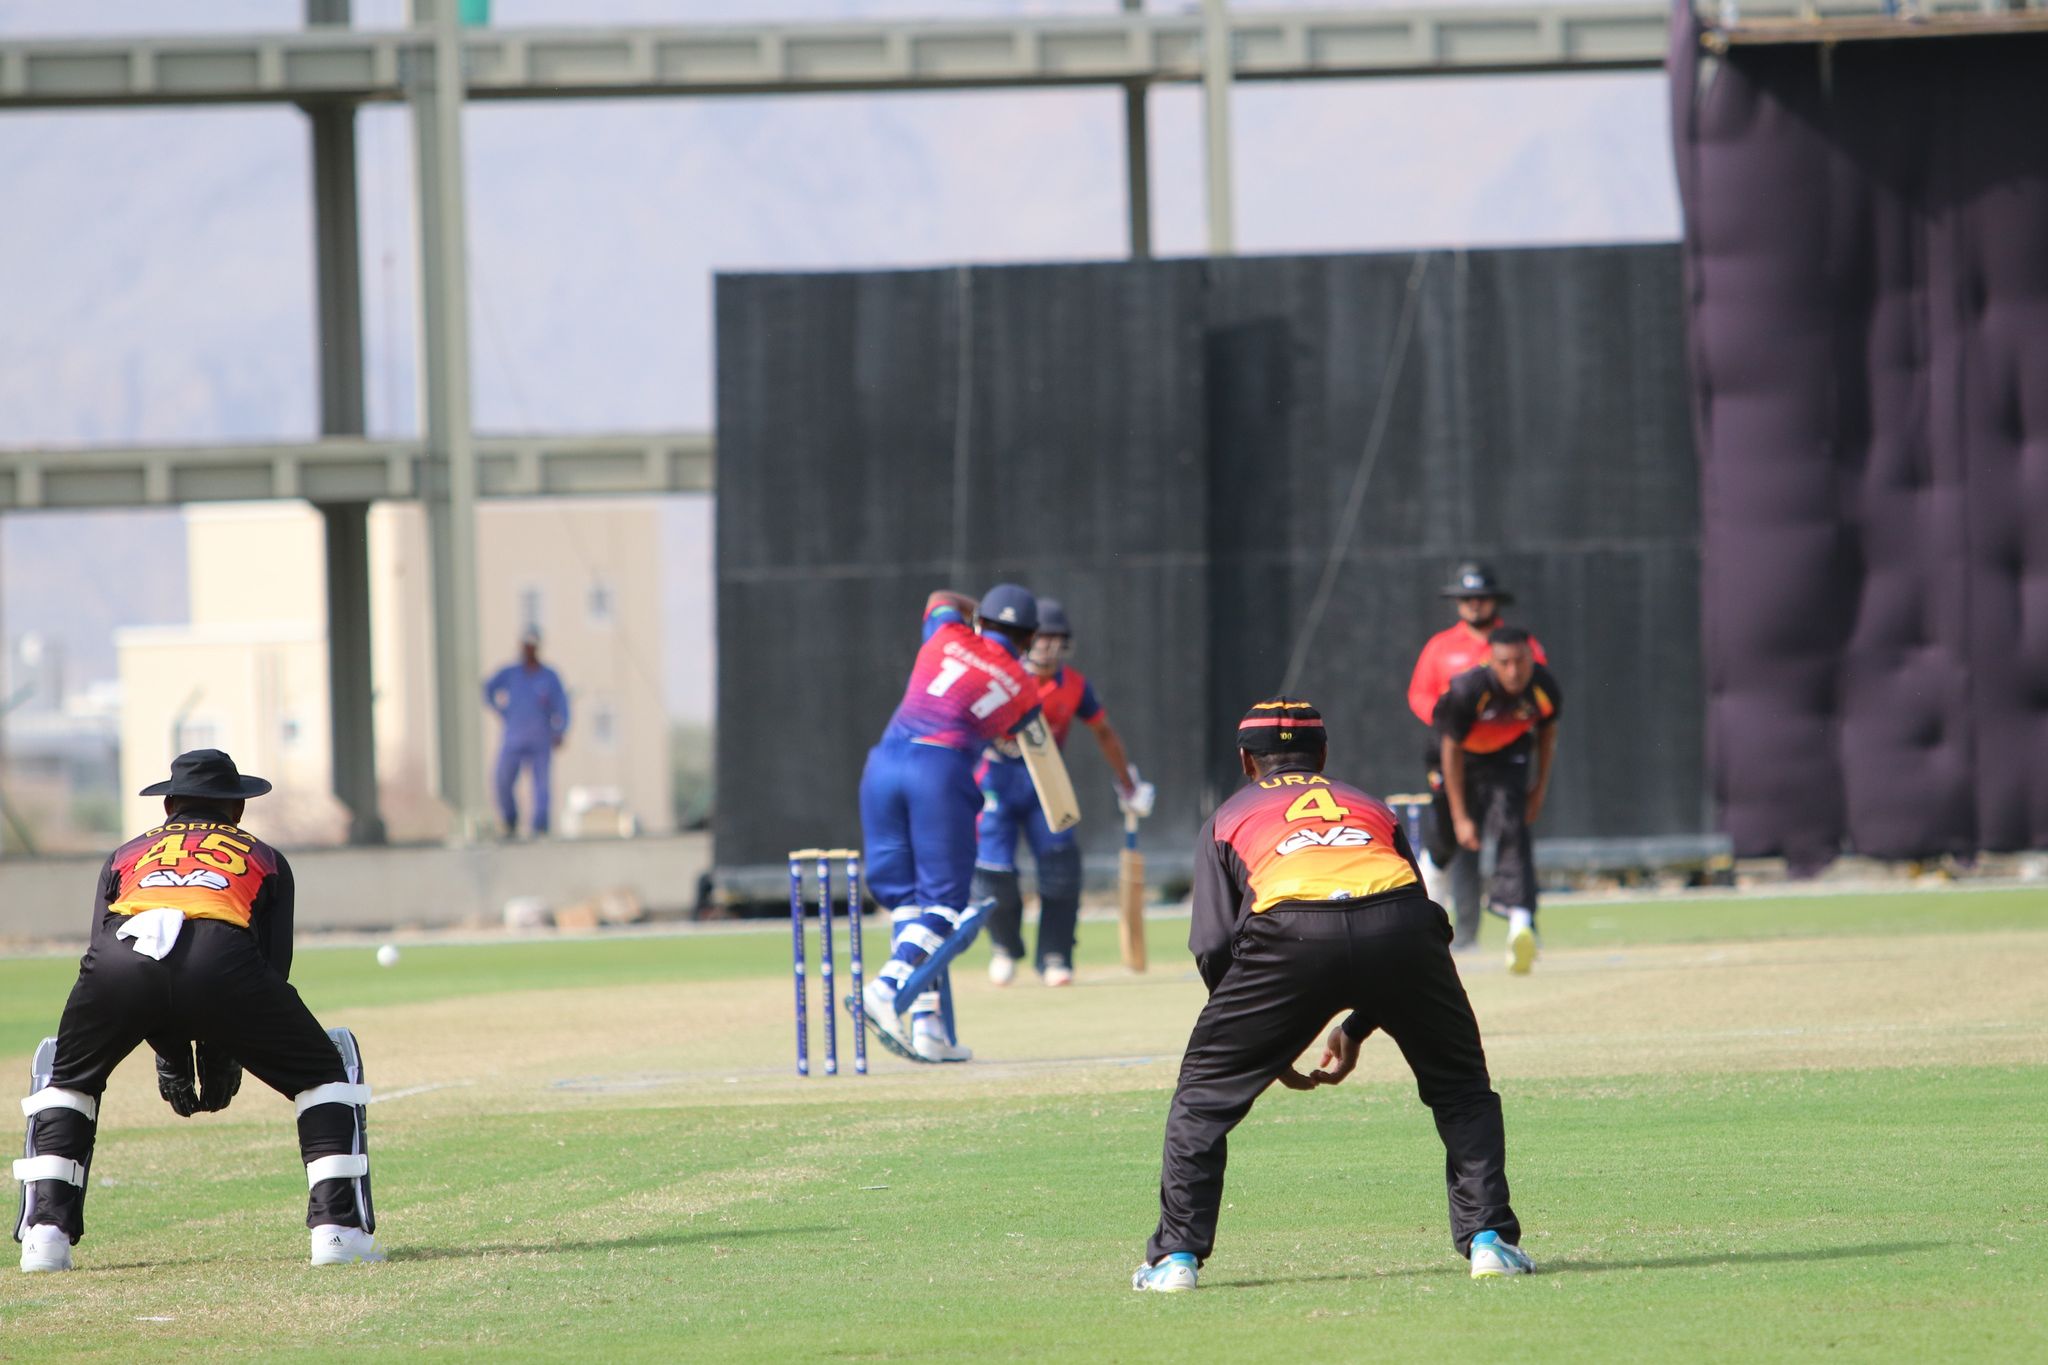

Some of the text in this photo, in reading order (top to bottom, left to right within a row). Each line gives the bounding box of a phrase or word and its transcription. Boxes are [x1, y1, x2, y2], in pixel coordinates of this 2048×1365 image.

[1259, 775, 1331, 789] URA
[1284, 787, 1351, 823] 4
[145, 823, 257, 843] DORIGA
[133, 832, 252, 876] 45
